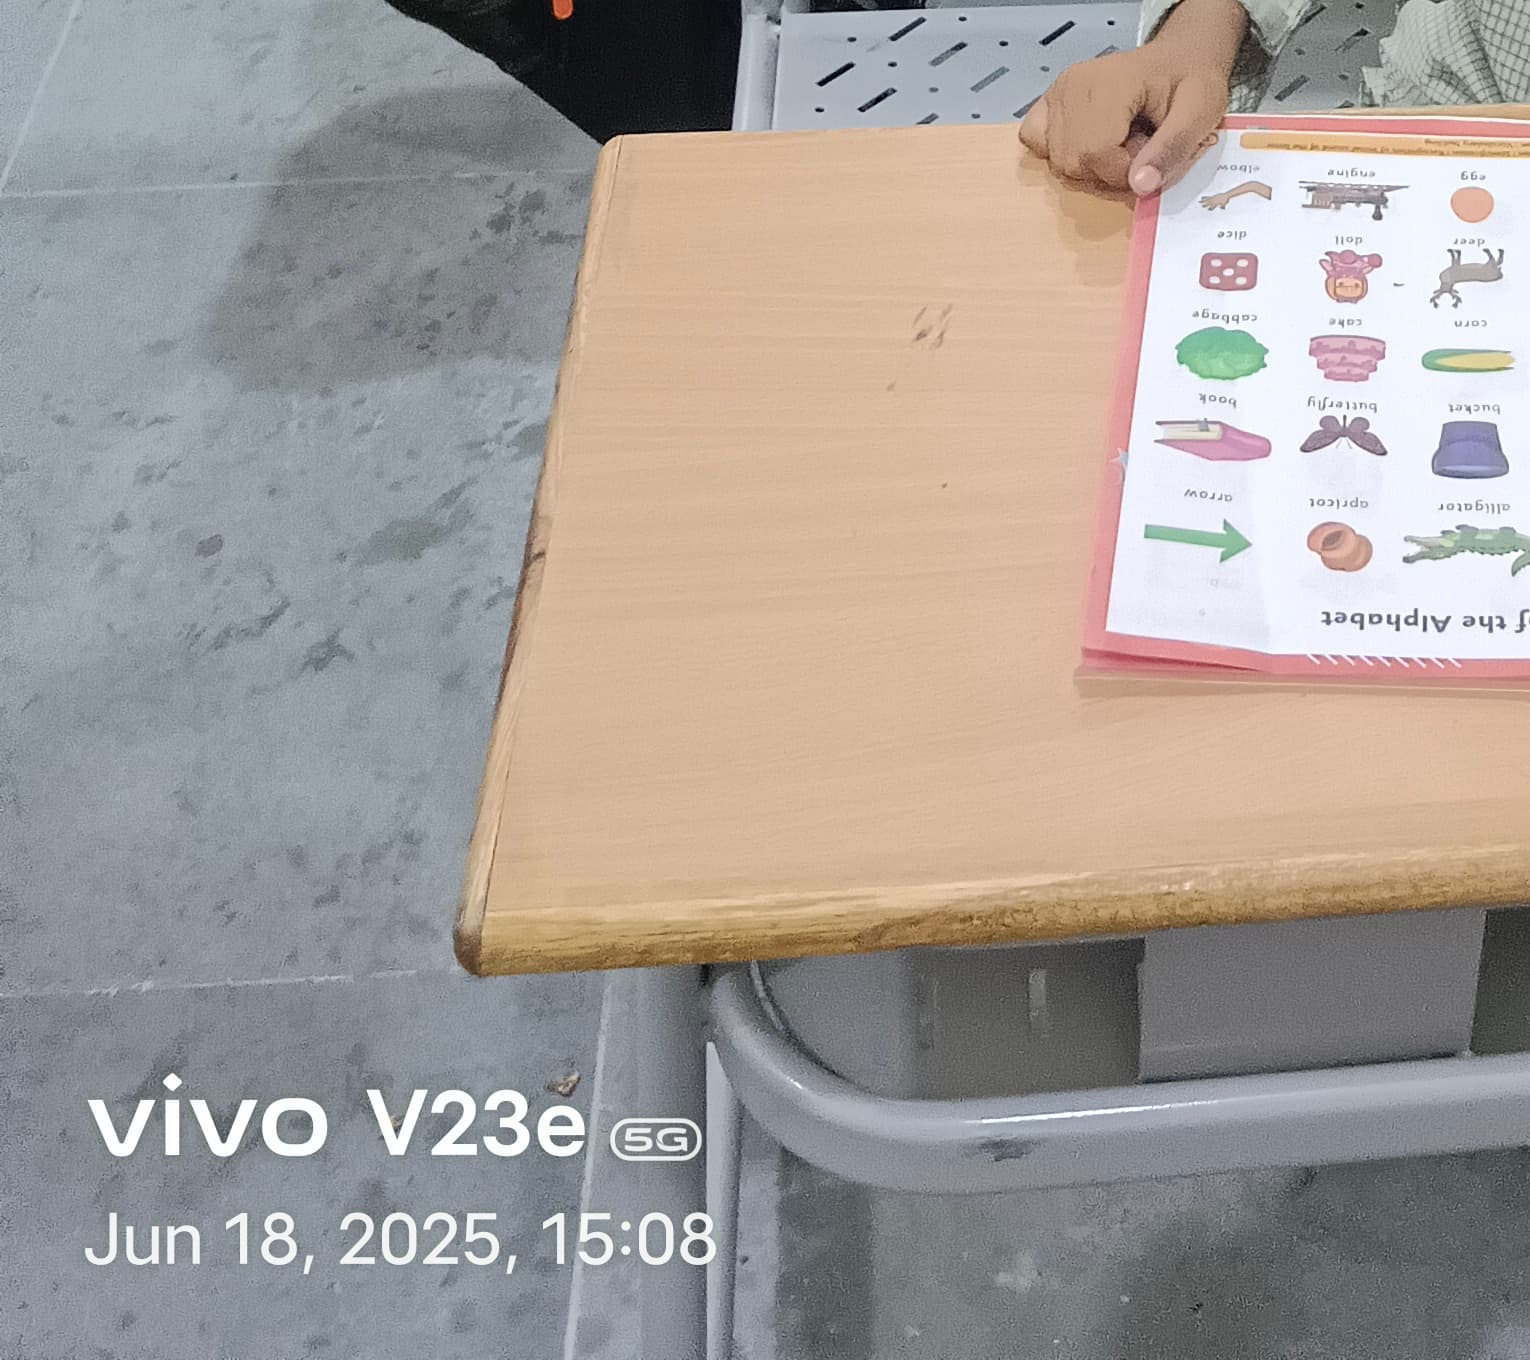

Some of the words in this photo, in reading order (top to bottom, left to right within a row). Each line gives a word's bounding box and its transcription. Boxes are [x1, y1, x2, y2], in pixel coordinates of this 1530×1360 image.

[1216, 163, 1261, 176] elbow
[1328, 168, 1375, 178] engine
[1460, 170, 1487, 184] egg
[1217, 231, 1246, 240] dice
[1336, 236, 1362, 246] doll
[1454, 238, 1485, 247] deer
[1192, 309, 1257, 324] cabbage
[1329, 319, 1362, 328] cake
[1453, 319, 1488, 330] corn
[1199, 394, 1236, 408] book
[1308, 396, 1377, 413] butterfly
[1449, 404, 1500, 415] bucket
[1184, 489, 1232, 502] arrow
[1310, 497, 1368, 509] apricot
[1438, 500, 1510, 514] alligator
[1322, 608, 1451, 632] Alphabet
[1463, 616, 1506, 633] the
